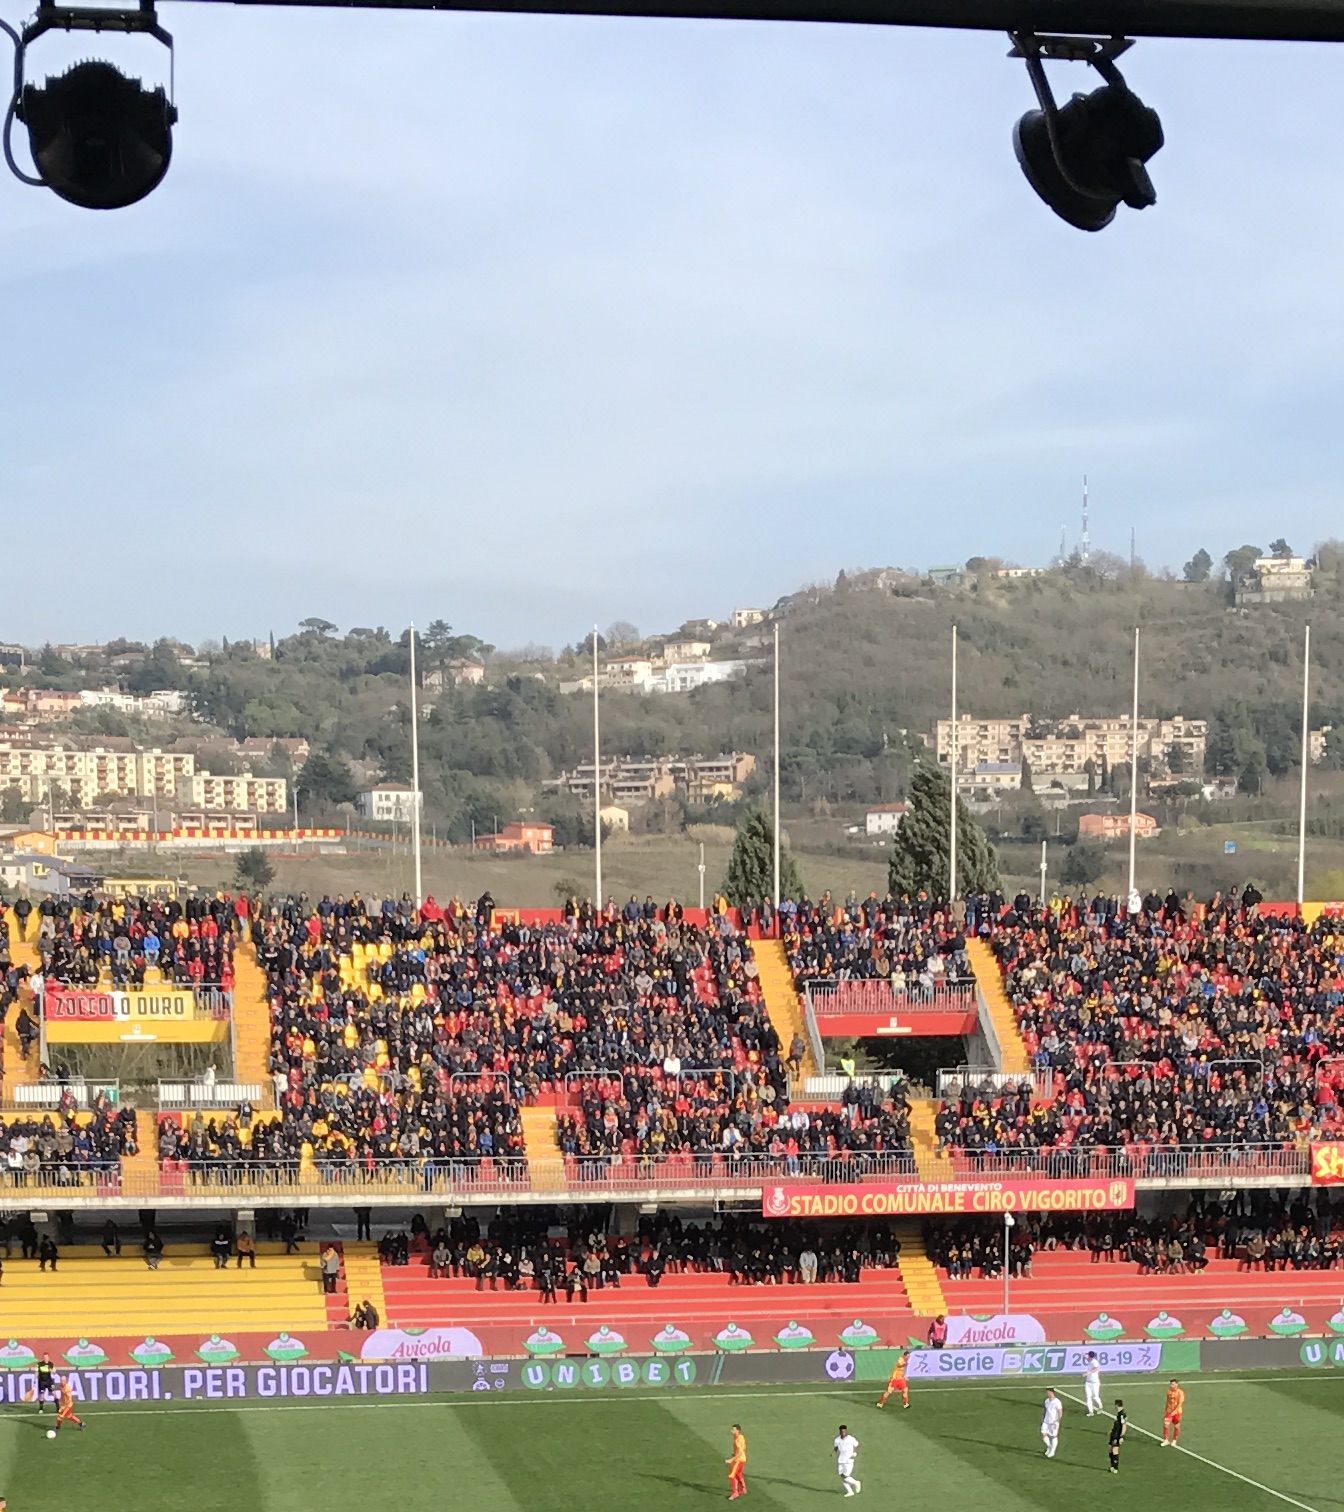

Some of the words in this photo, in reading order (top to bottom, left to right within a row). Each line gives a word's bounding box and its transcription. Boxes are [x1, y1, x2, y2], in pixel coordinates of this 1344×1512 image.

[56, 996, 130, 1017] ZOCCOLO
[137, 996, 184, 1015] DURO
[896, 1183, 926, 1193] CITTÀ
[928, 1184, 939, 1192] DI
[941, 1182, 1002, 1192] BENEVENTO
[790, 1194, 858, 1215] STADIO
[862, 1192, 965, 1214] COMUNALE
[972, 1190, 1015, 1211] CIRO
[1019, 1189, 1106, 1210] VIGORITO
[958, 1322, 1016, 1343] Avicola
[391, 1337, 451, 1358] Avicola
[939, 1352, 994, 1373] Serie
[1002, 1349, 1066, 1373] BKT
[184, 1368, 246, 1398] PER
[257, 1364, 428, 1396] GIOCATORI
[526, 1360, 691, 1385] UNIBET
